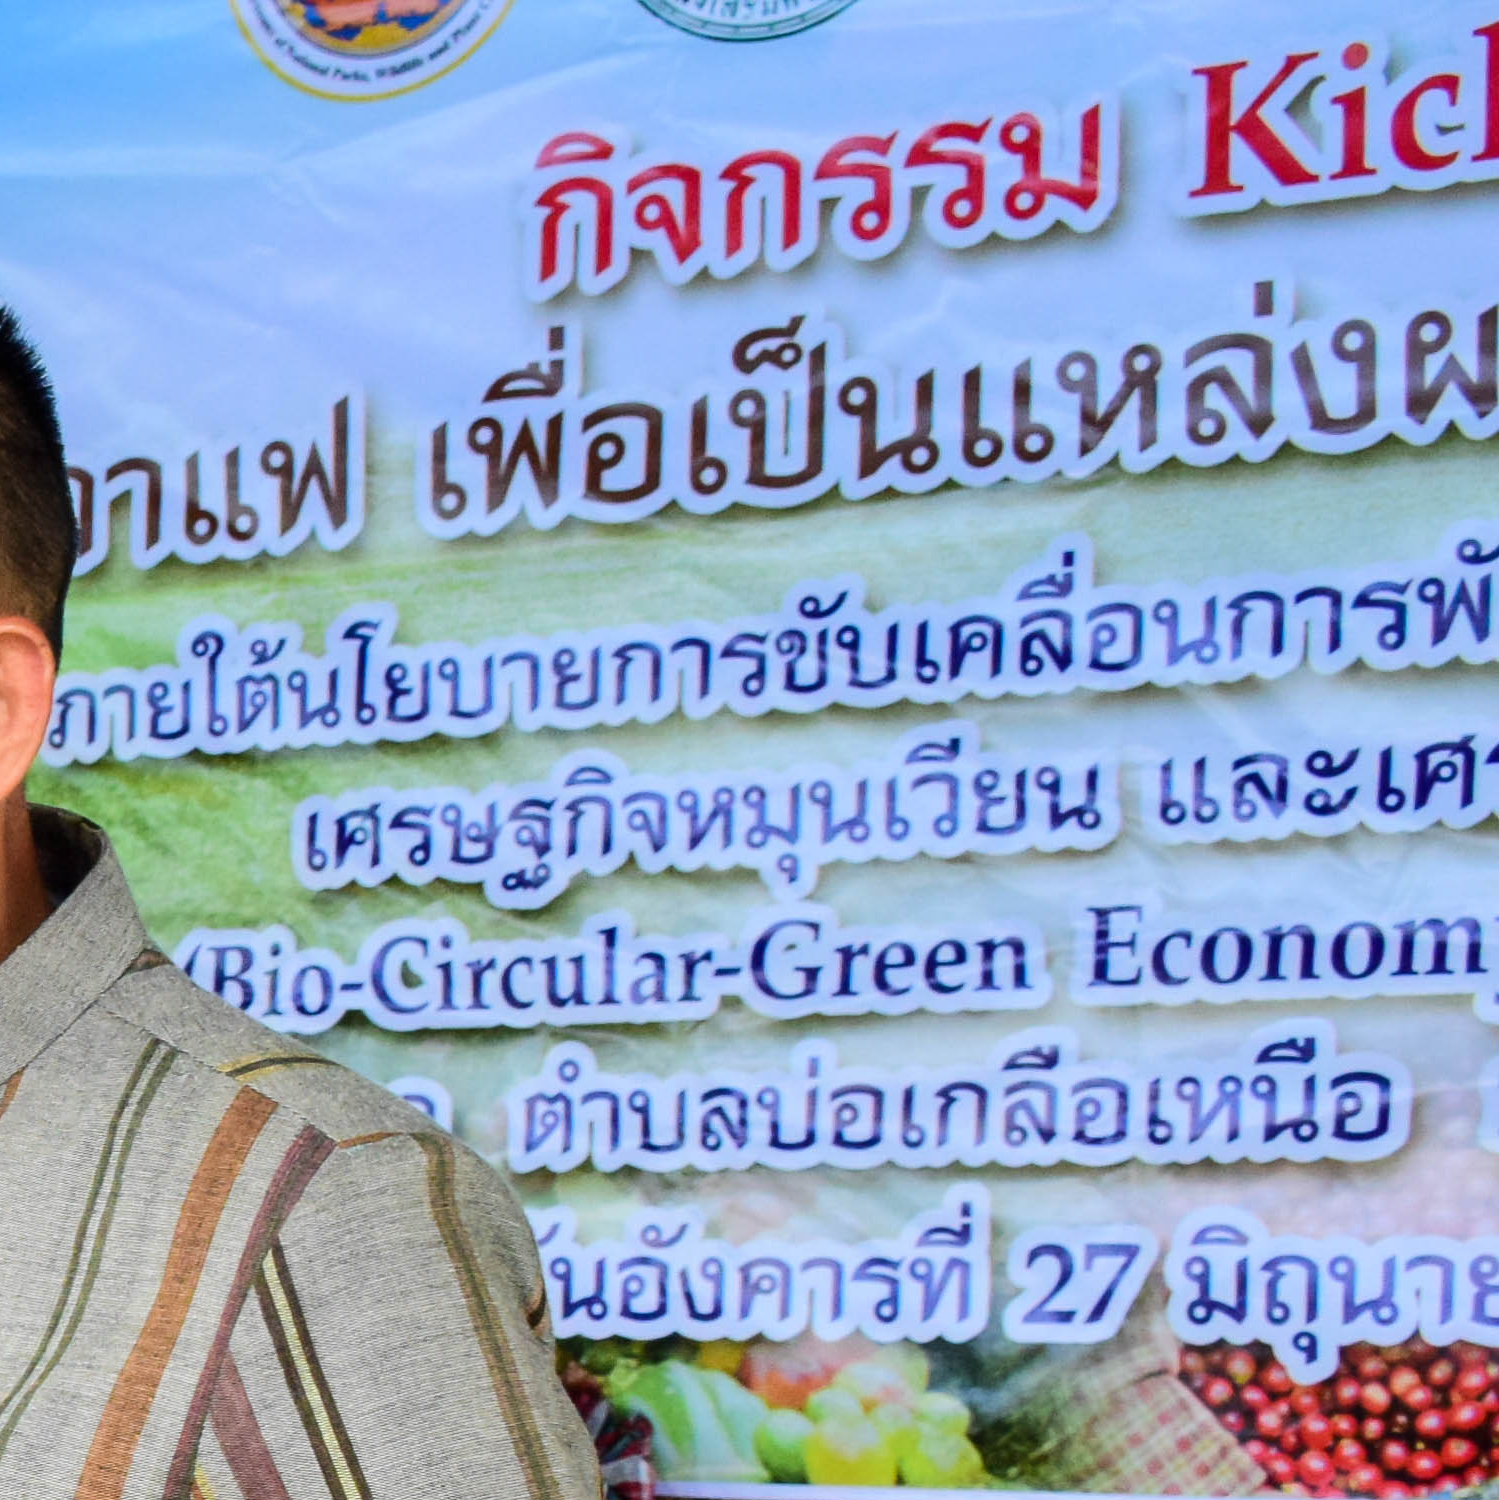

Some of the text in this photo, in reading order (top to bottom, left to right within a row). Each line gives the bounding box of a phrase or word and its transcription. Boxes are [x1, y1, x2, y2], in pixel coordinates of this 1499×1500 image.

[535, 102, 1101, 283] กิจกรรม
[307, 738, 1102, 889] เศรษฐกิจหมุนเวียน
[1084, 904, 1499, 1004] Econom
[523, 1036, 1392, 1156] ตำบลบ่อเกลือเหนือ
[1021, 1242, 1140, 1326] 27
